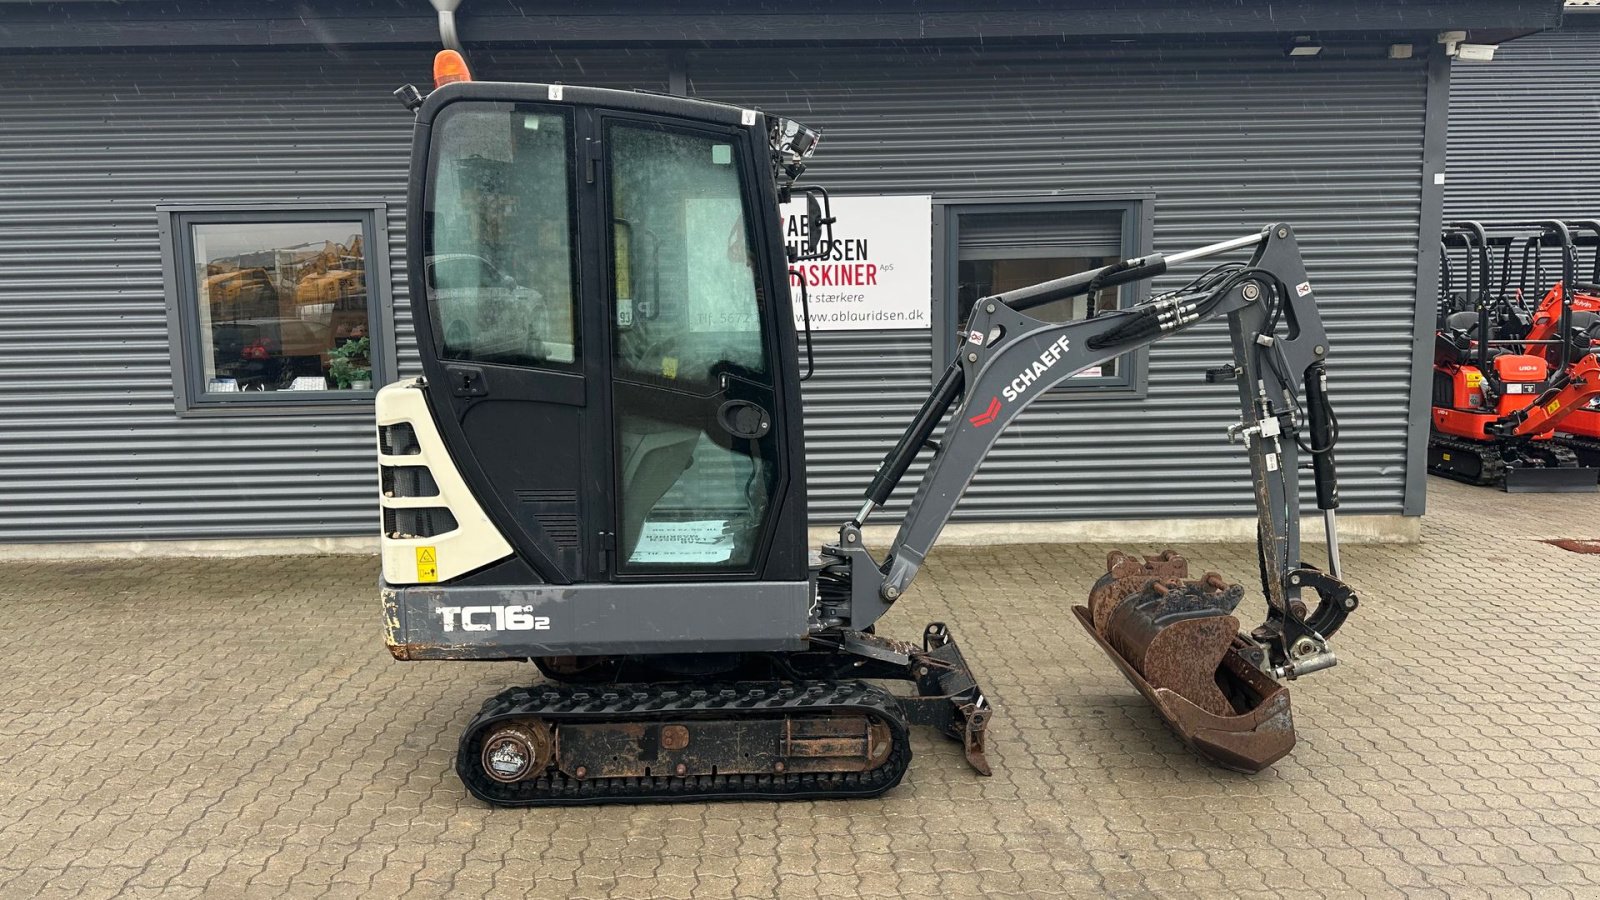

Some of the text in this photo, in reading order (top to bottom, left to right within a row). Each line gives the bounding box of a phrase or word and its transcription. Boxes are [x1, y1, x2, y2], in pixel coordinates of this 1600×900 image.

[787, 215, 809, 236] AB
[880, 264, 894, 272] ApS
[815, 292, 865, 303] stærkere
[796, 310, 924, 322] www.ablauridsen.dk
[1002, 335, 1070, 402] SCHAEFF
